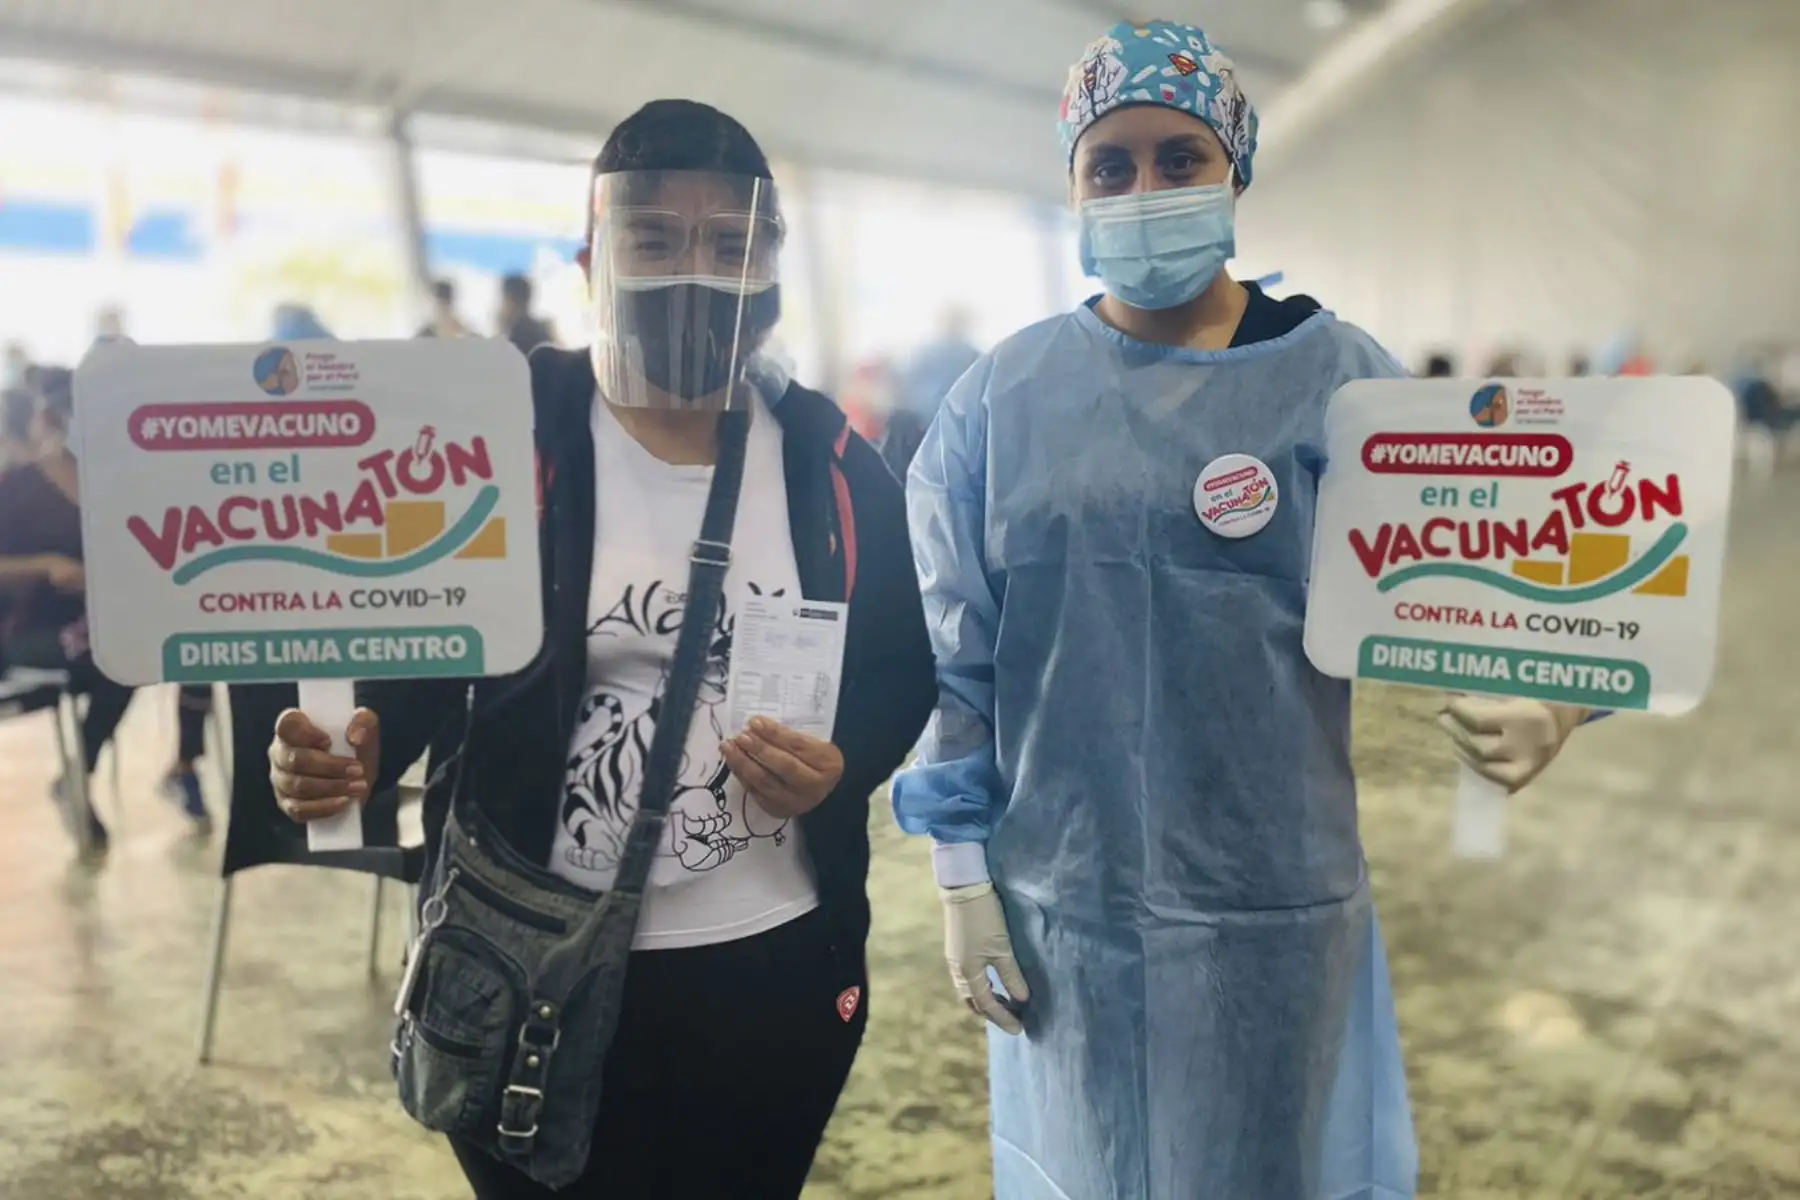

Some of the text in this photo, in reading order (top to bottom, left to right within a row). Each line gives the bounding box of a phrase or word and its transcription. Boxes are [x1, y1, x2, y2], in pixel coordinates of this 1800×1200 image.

[140, 413, 361, 440] #YOMEVACUNO
[210, 454, 300, 485] en el
[1369, 444, 1560, 468] #YOMEVACUNO
[1420, 482, 1499, 509] en el
[199, 586, 467, 613] CONTRA LA COVID-19
[1394, 602, 1640, 640] CONTRA LA COVID-19
[179, 634, 468, 667] DIRIS LIMA CENTRO
[1372, 643, 1635, 694] DIRIS LIMA CENTRO
